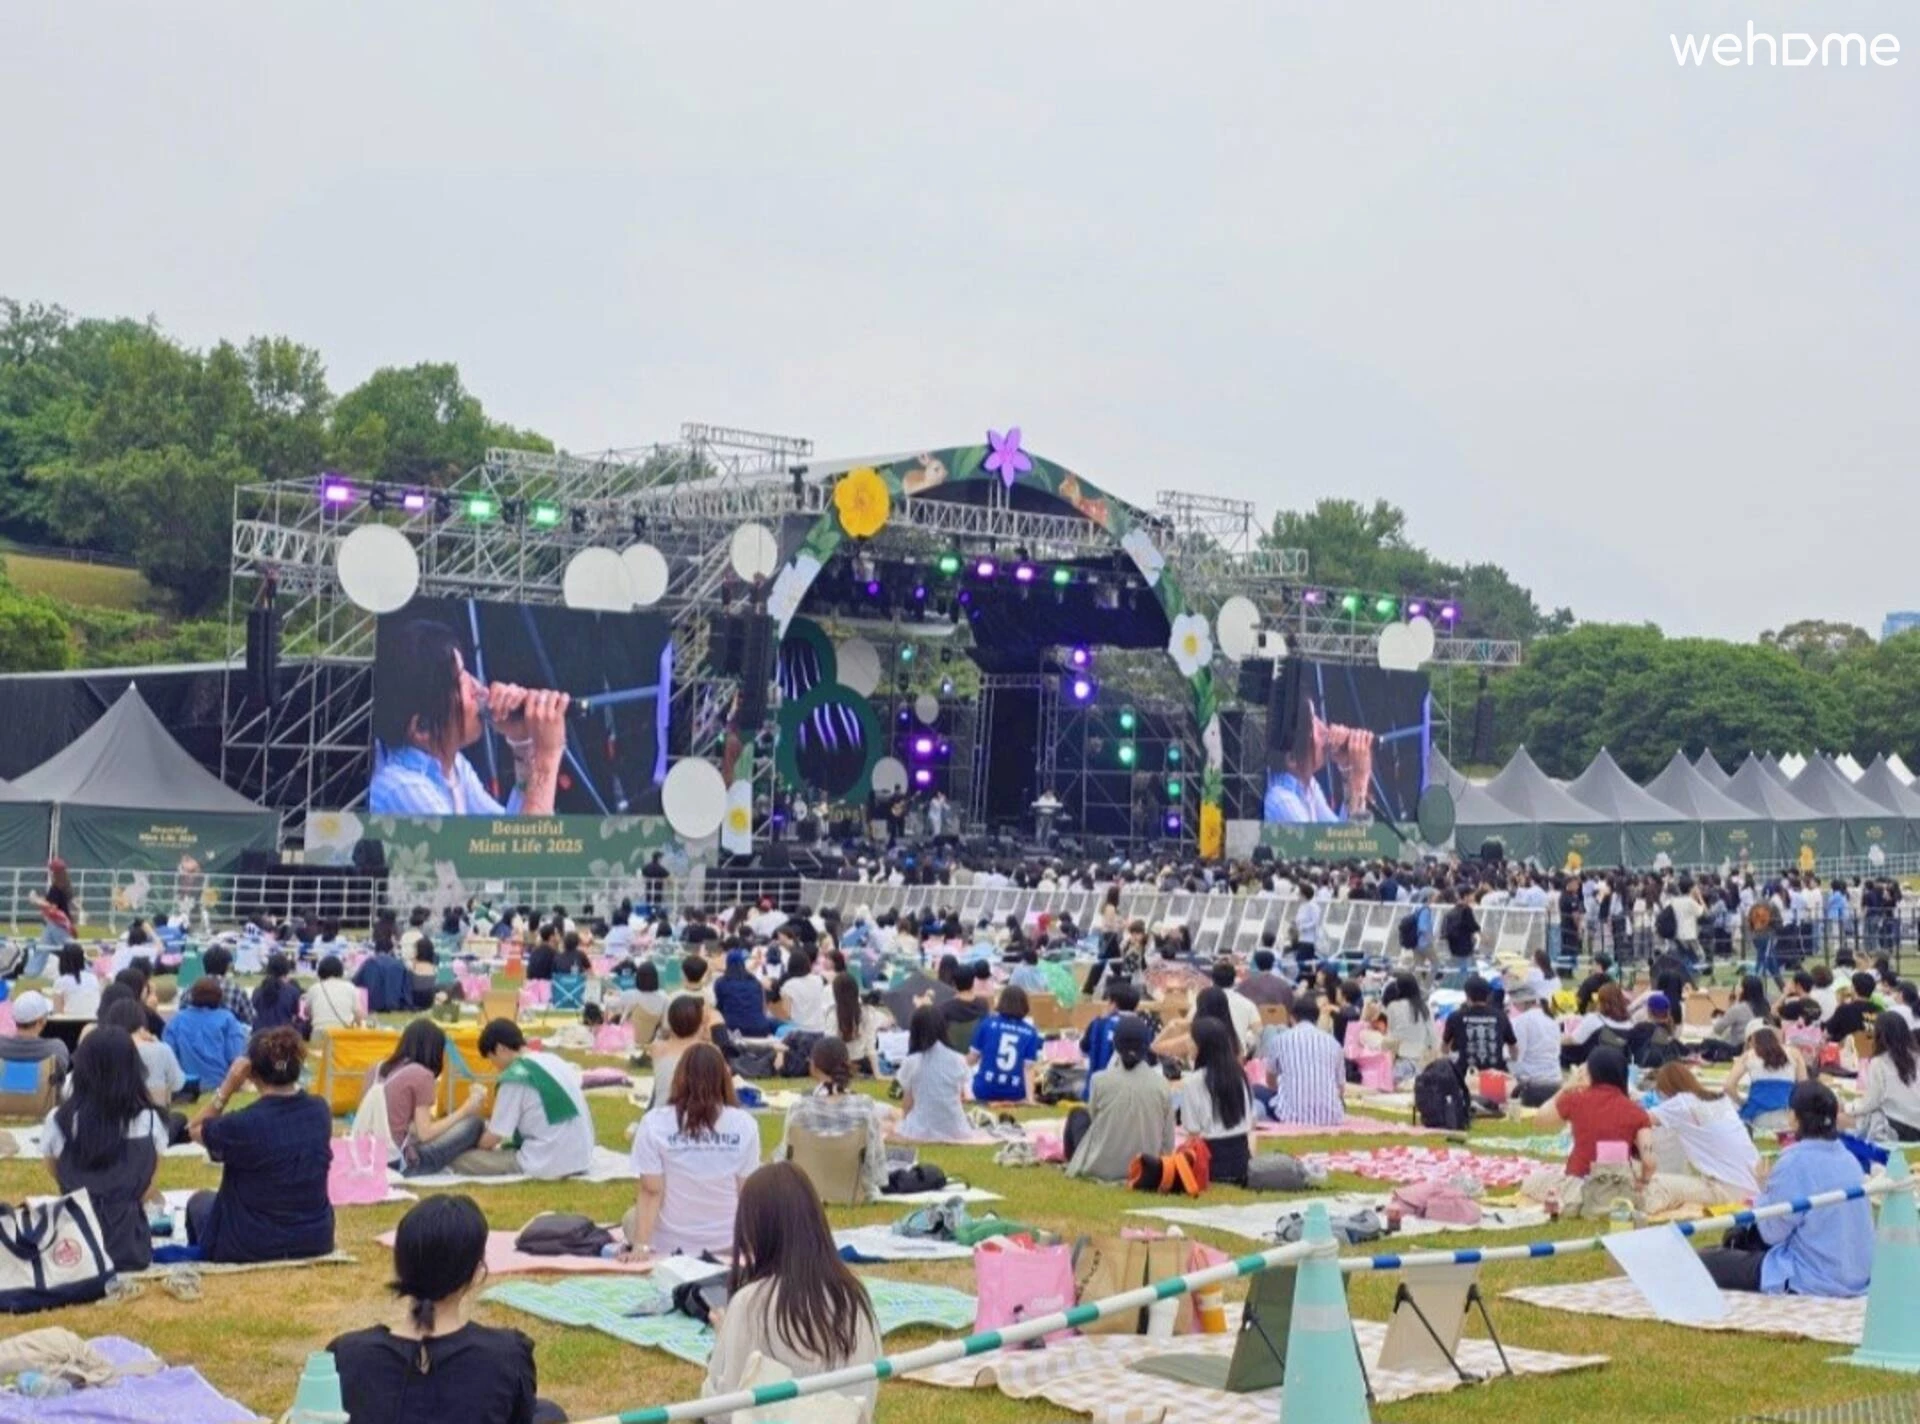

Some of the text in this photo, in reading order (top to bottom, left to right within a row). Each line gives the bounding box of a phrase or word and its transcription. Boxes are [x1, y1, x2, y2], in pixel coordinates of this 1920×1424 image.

[491, 819, 564, 836] Beautiful
[468, 838, 583, 854] Mint Life 2025
[996, 1031, 1020, 1072] 5
